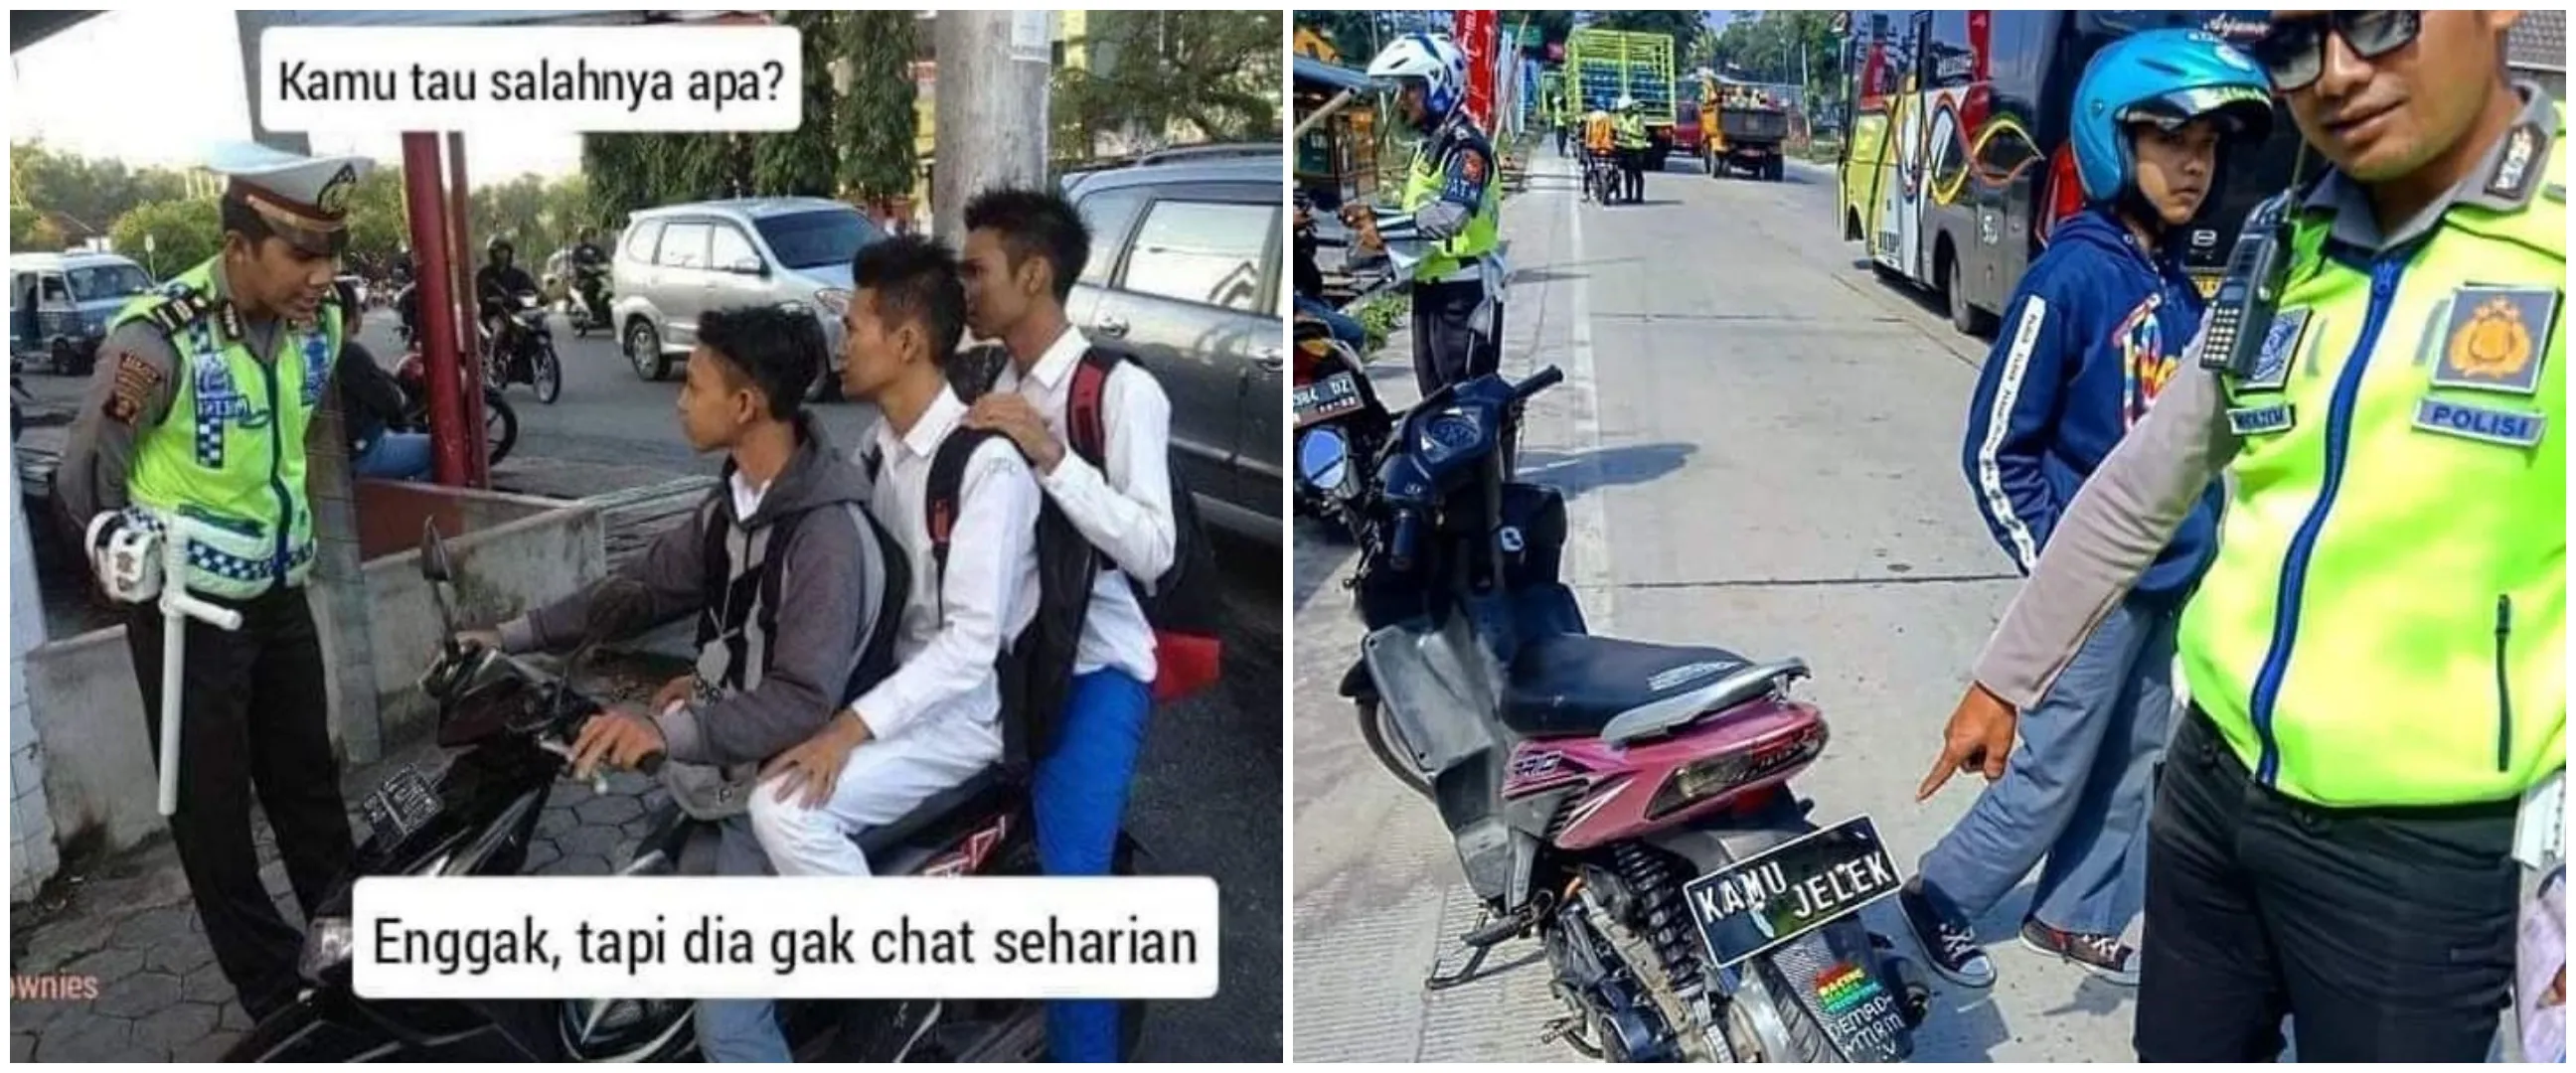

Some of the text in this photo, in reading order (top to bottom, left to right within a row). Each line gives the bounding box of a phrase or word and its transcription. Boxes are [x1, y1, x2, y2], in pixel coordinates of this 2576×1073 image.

[2432, 404, 2528, 437] POLISI
[1696, 851, 1893, 923] KAMU JELEK
